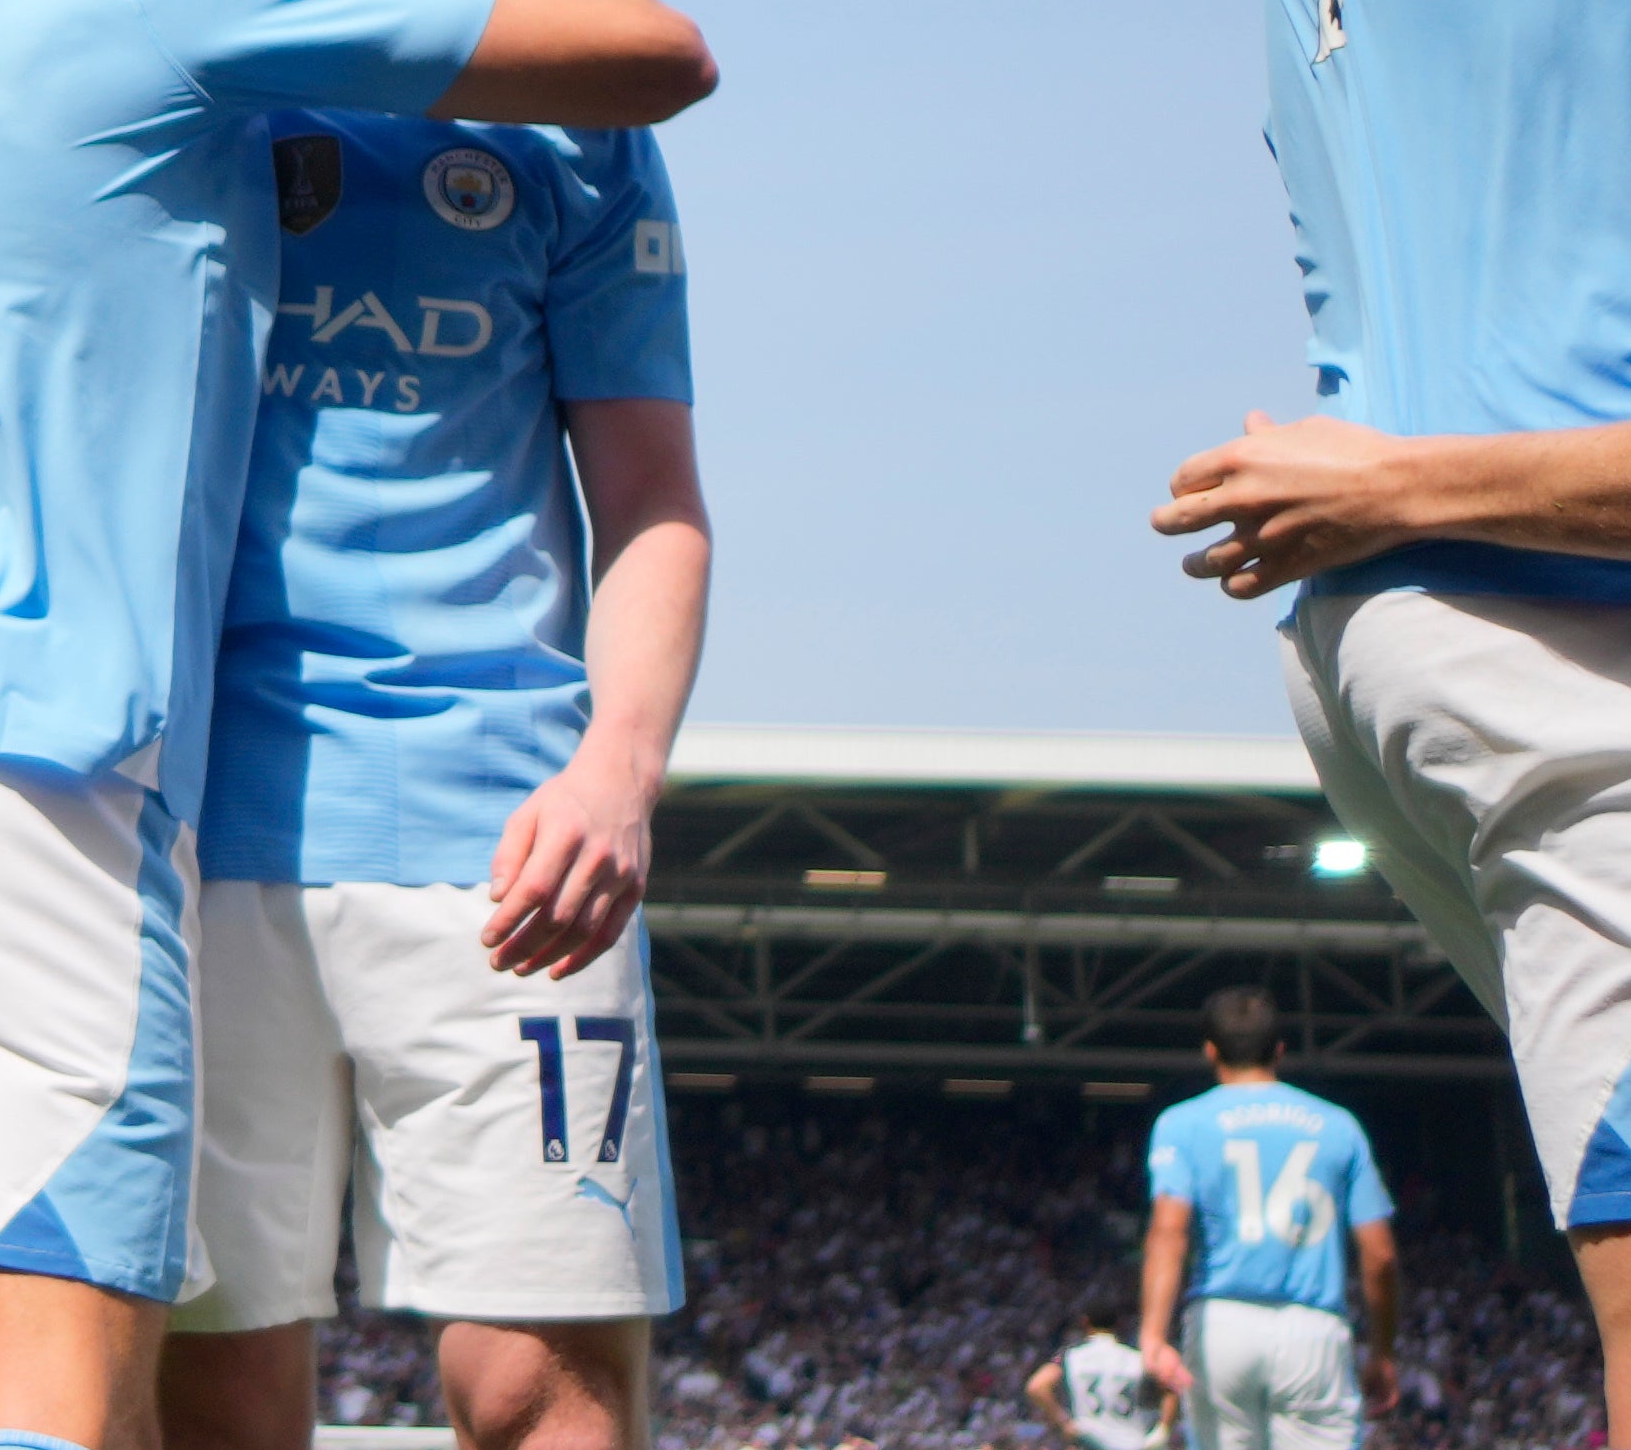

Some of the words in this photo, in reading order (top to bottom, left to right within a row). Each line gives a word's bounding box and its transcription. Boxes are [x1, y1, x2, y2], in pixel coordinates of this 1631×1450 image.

[517, 1014, 637, 1163] 17
[1223, 1138, 1338, 1248] 16
[1079, 1371, 1138, 1420] 33
